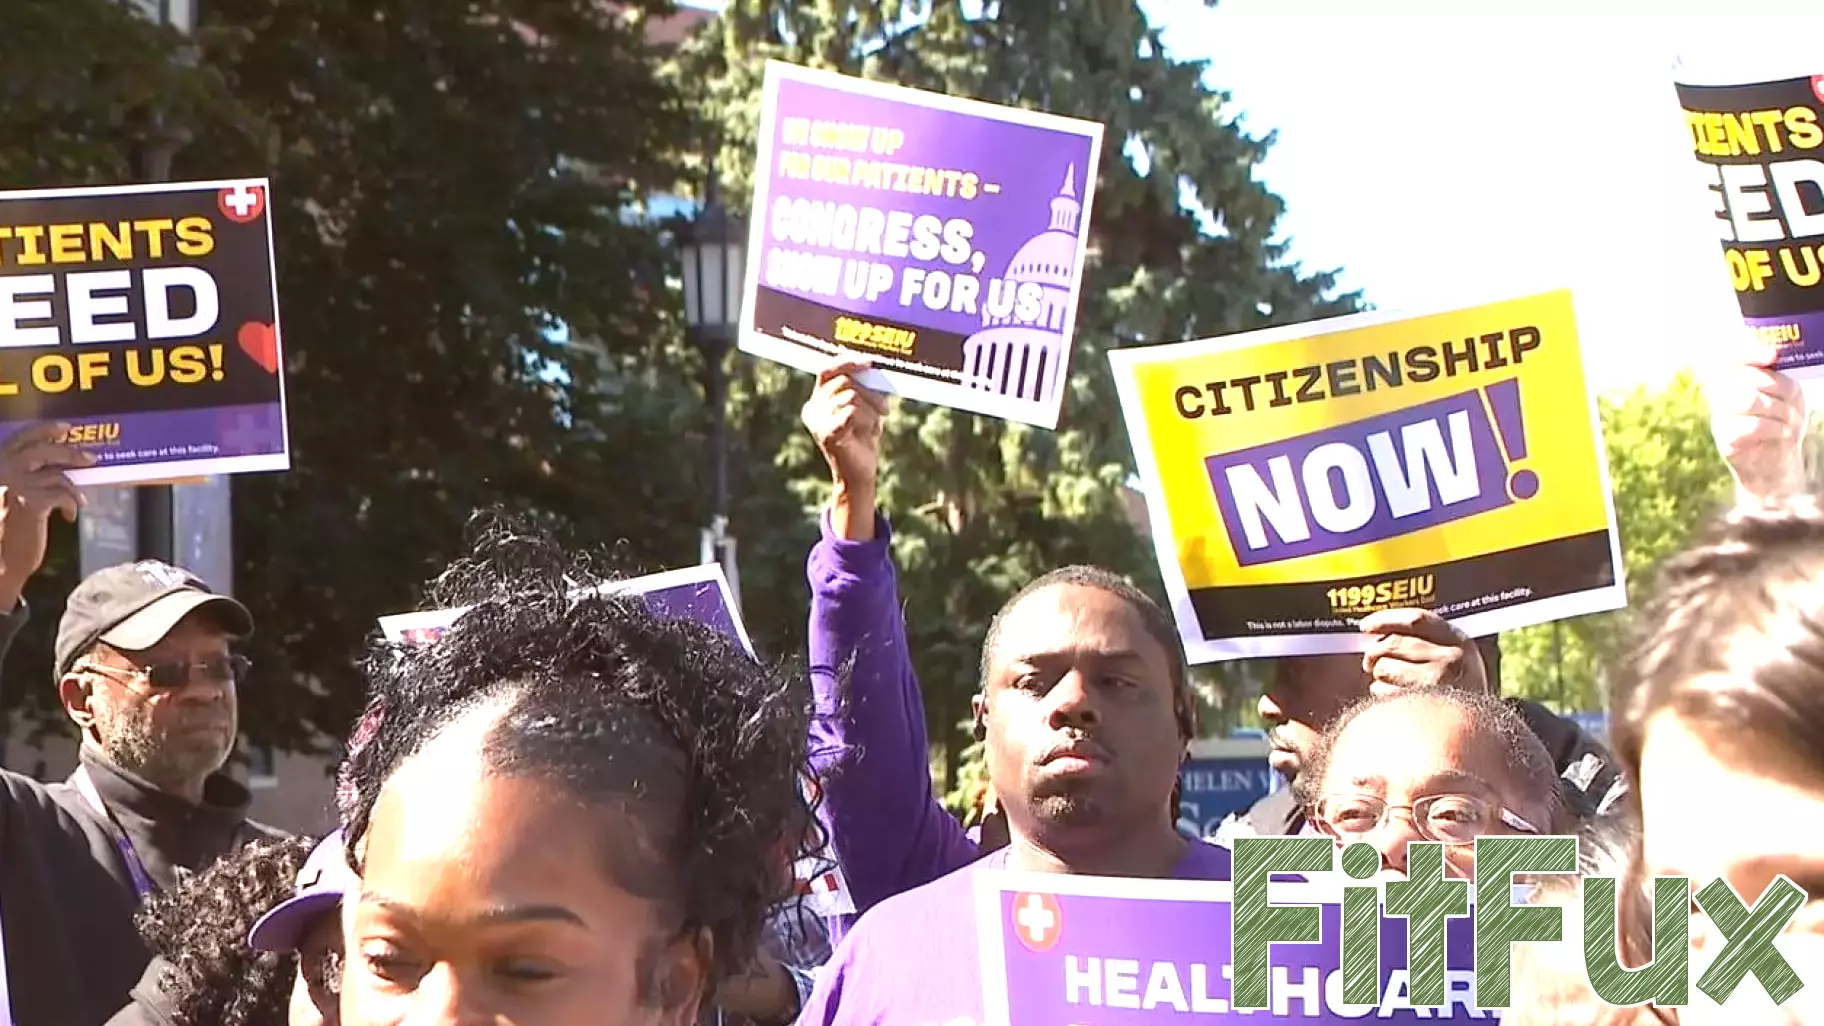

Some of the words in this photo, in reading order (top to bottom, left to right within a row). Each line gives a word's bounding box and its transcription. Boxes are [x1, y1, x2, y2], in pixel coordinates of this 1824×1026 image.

[852, 159, 978, 200] PATIENTS
[0, 216, 214, 267] IENTS
[772, 196, 986, 273] CONGRESS,
[843, 259, 893, 302] UP
[900, 267, 979, 314] FOR
[987, 278, 1044, 322] US
[1724, 248, 1775, 291] OF
[1779, 245, 1824, 287] U
[31, 353, 110, 393] OF
[124, 343, 226, 387] US!
[1174, 325, 1541, 419] CITIZENSHIP
[1224, 377, 1540, 552] NOW!
[1326, 573, 1435, 607] 1199SEIU
